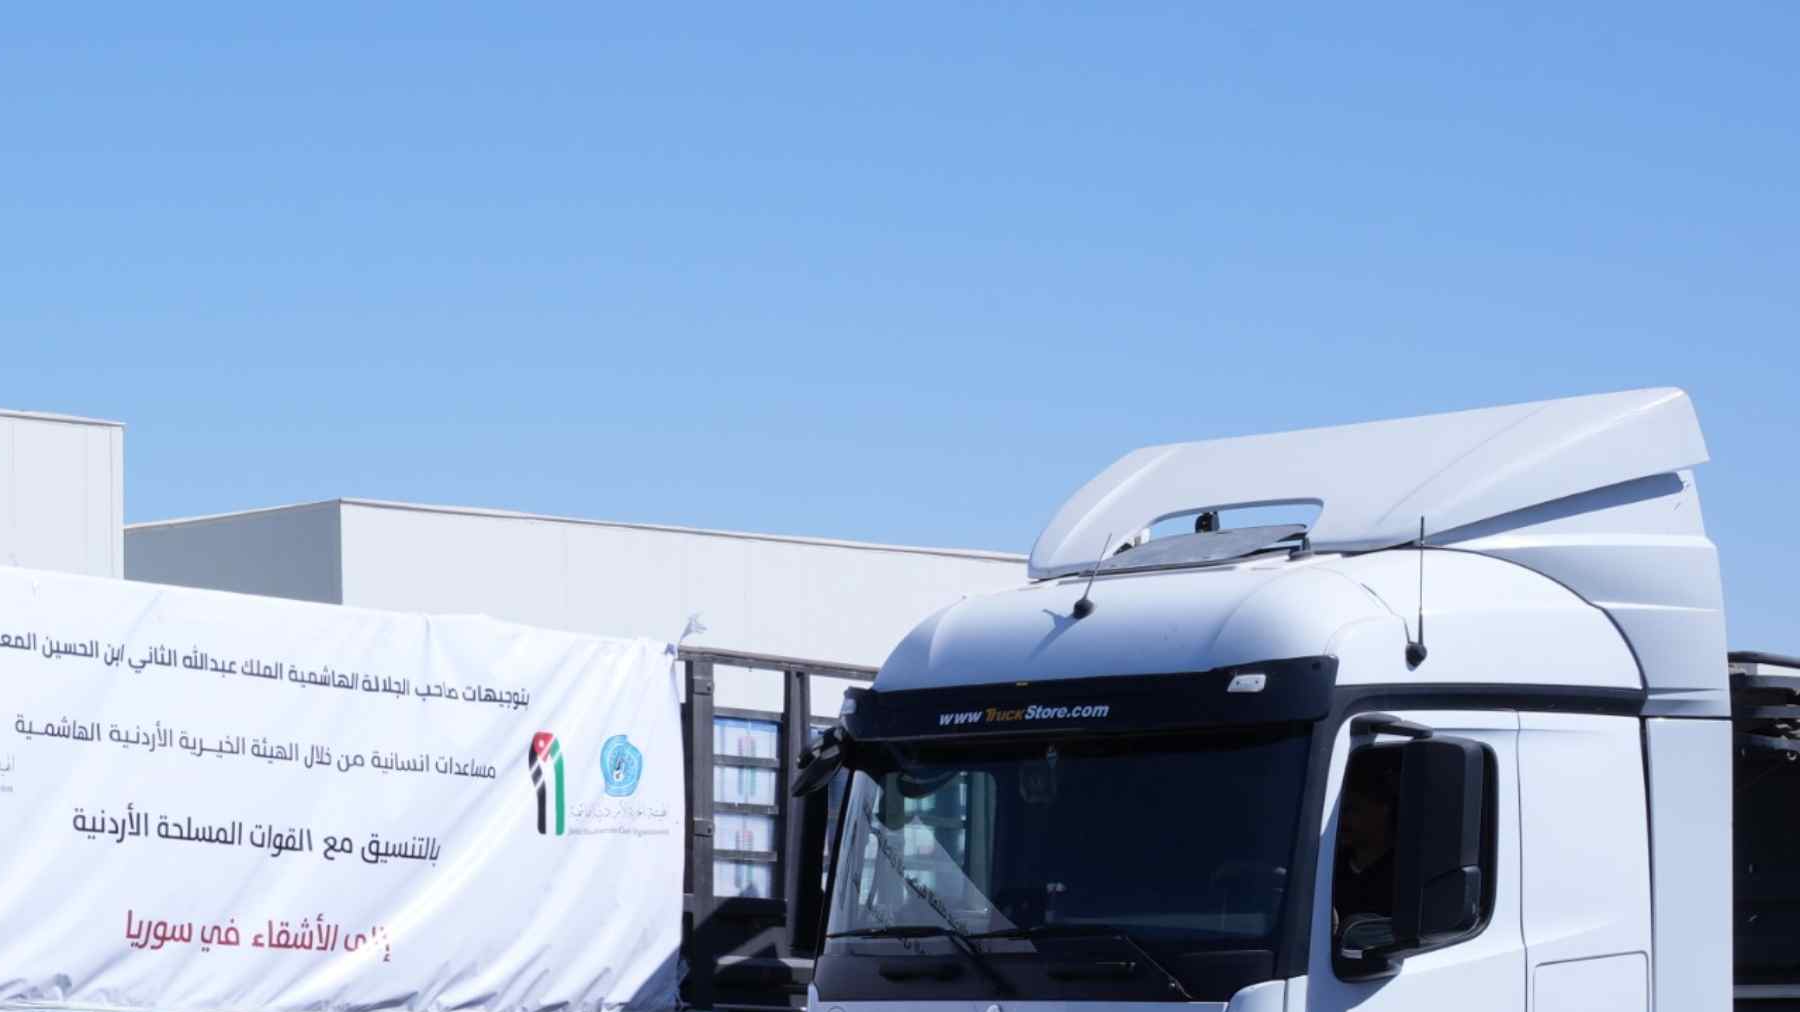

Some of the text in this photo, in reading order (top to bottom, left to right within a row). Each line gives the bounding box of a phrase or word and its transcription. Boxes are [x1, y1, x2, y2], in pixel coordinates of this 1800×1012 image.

[41, 635, 99, 659] الحسين
[104, 643, 125, 667] ابن
[128, 645, 178, 674] الثاني
[181, 646, 238, 678] عبدالله
[241, 659, 284, 681] الملك
[288, 664, 359, 688] الهاشمية
[361, 673, 410, 699] الجلالة
[414, 681, 459, 702] صاحب
[461, 685, 530, 711] بتوجيهات
[108, 719, 173, 753] الأردنية
[250, 737, 299, 764] الهيئة
[303, 745, 332, 769] خلال
[336, 753, 365, 773] من
[370, 750, 430, 775] انسانية
[435, 756, 496, 780] مساعدات
[72, 802, 441, 868] بالتنسيق مع القوات المسلحة الأردنية
[125, 909, 192, 951] سوريا
[200, 917, 241, 953] في
[251, 912, 339, 952] الأشقاء
